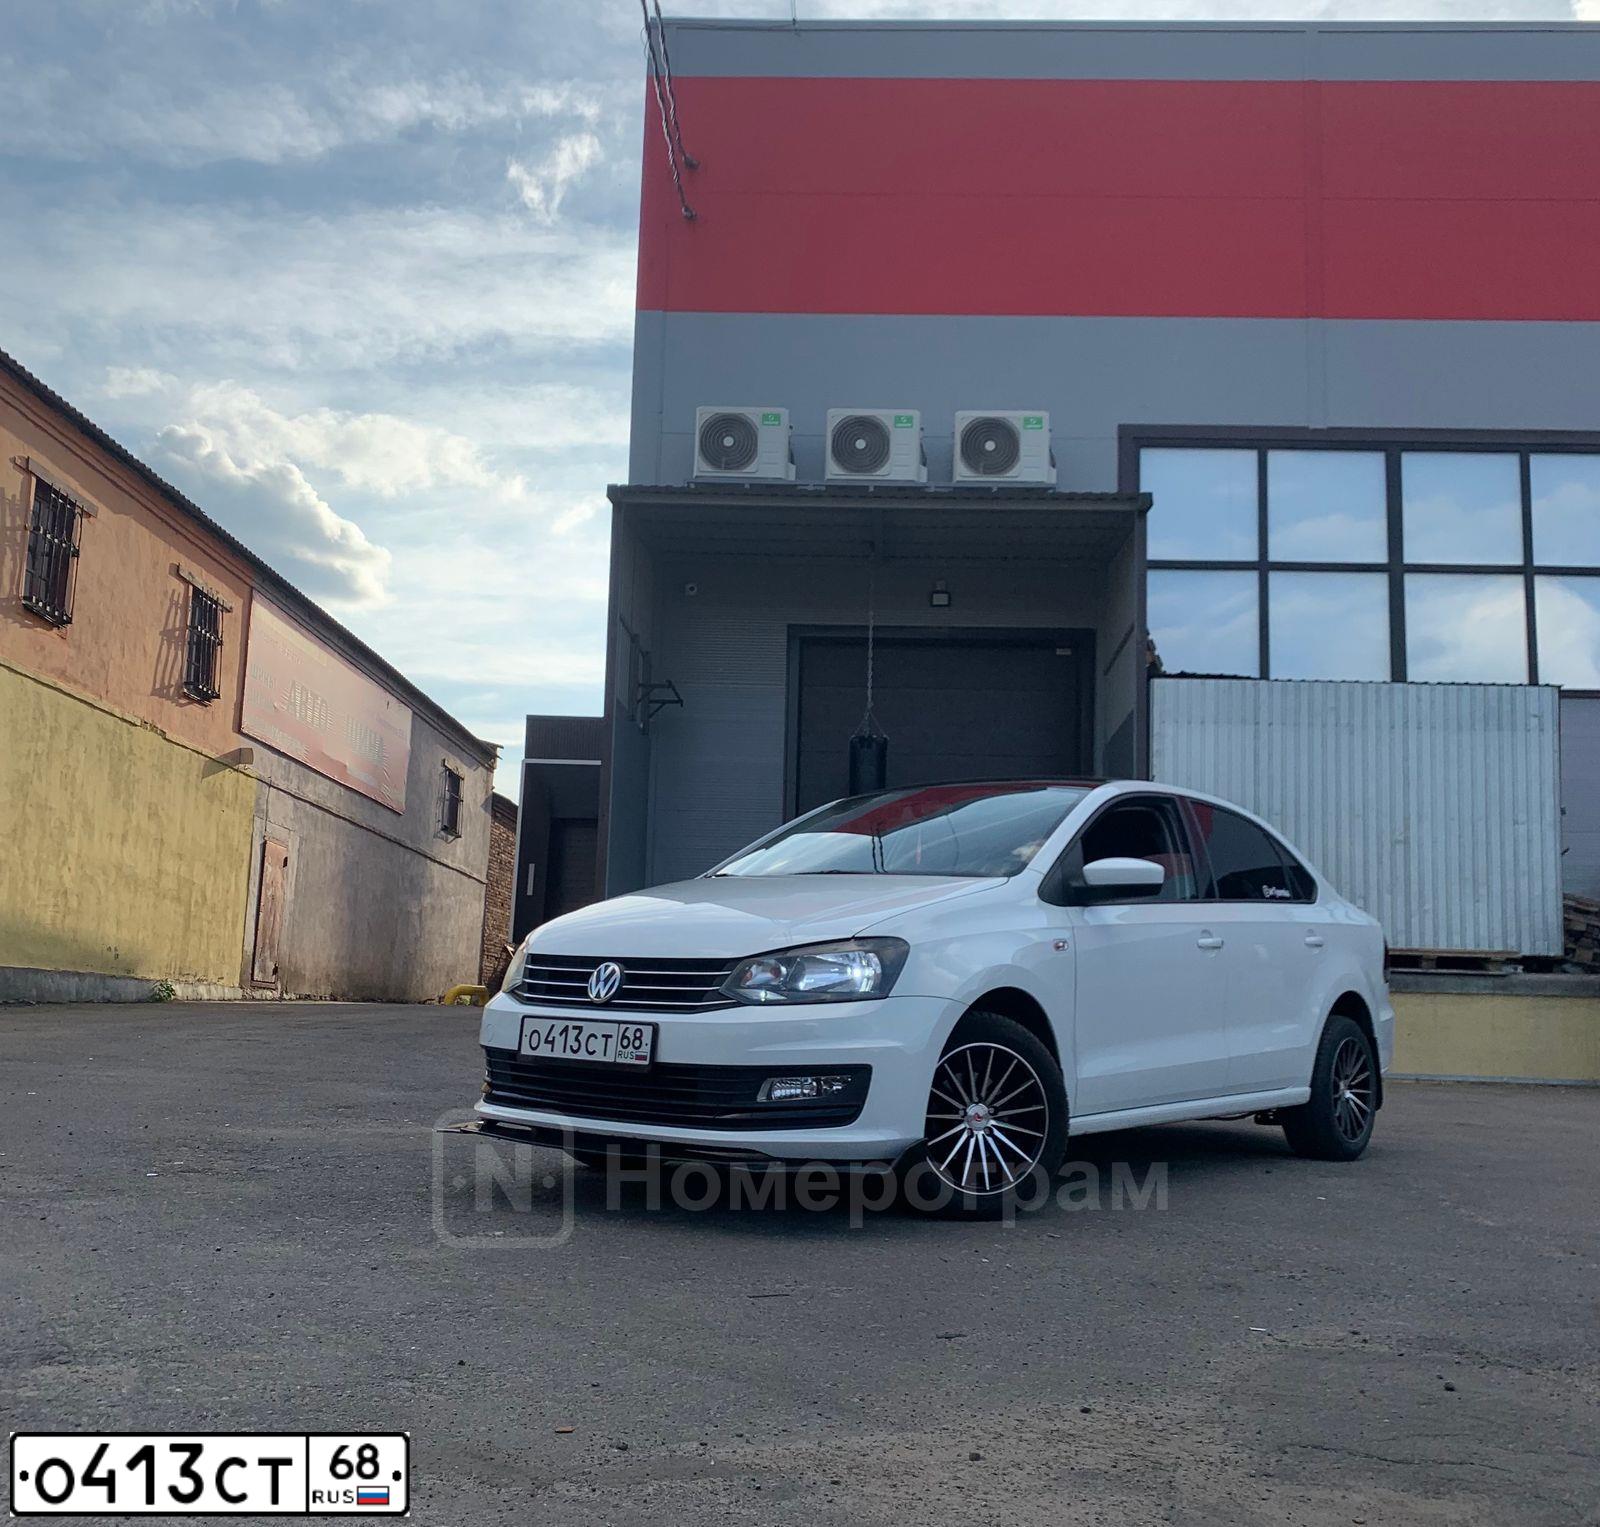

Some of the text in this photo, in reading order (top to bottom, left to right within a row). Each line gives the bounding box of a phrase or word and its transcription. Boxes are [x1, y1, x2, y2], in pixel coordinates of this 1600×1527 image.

[288, 679, 329, 732] АВТО
[528, 1023, 643, 1057] О413СТ 68
[617, 1051, 634, 1060] RUS
